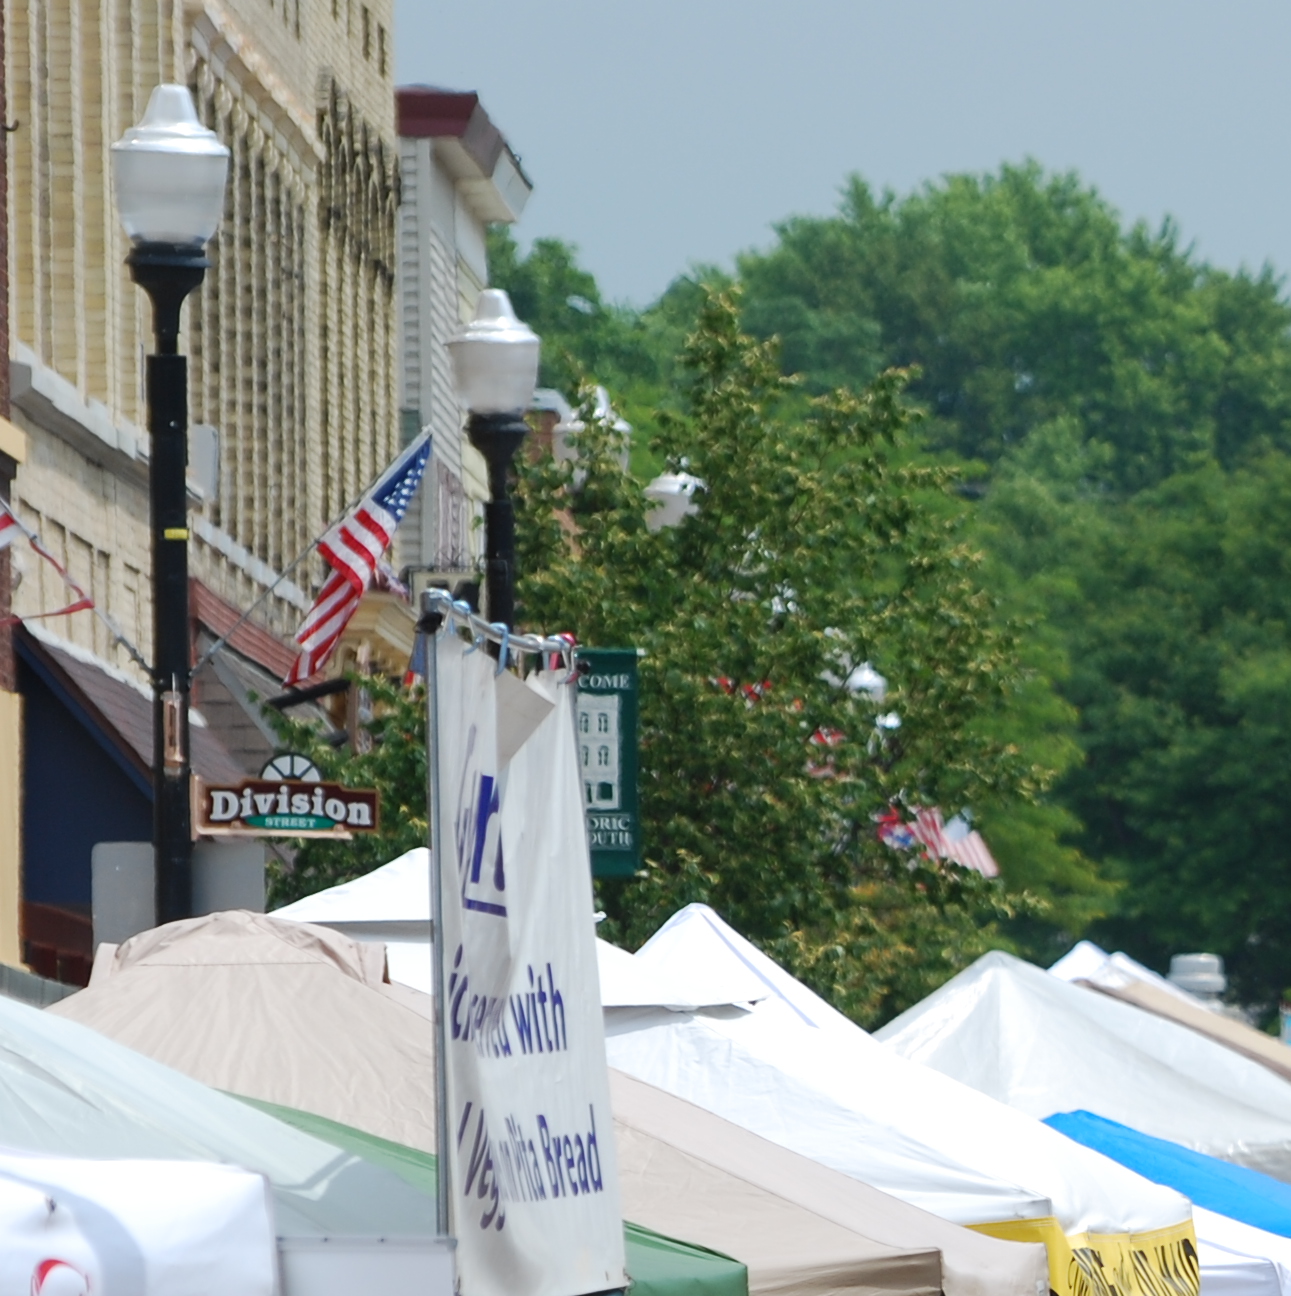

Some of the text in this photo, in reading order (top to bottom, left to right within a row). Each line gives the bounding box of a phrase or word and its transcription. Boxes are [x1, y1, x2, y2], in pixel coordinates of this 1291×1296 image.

[577, 673, 631, 689] COME
[209, 784, 372, 827] Division
[264, 816, 317, 829] STREET
[509, 962, 567, 1057] with
[536, 1103, 604, 1200] Bread
